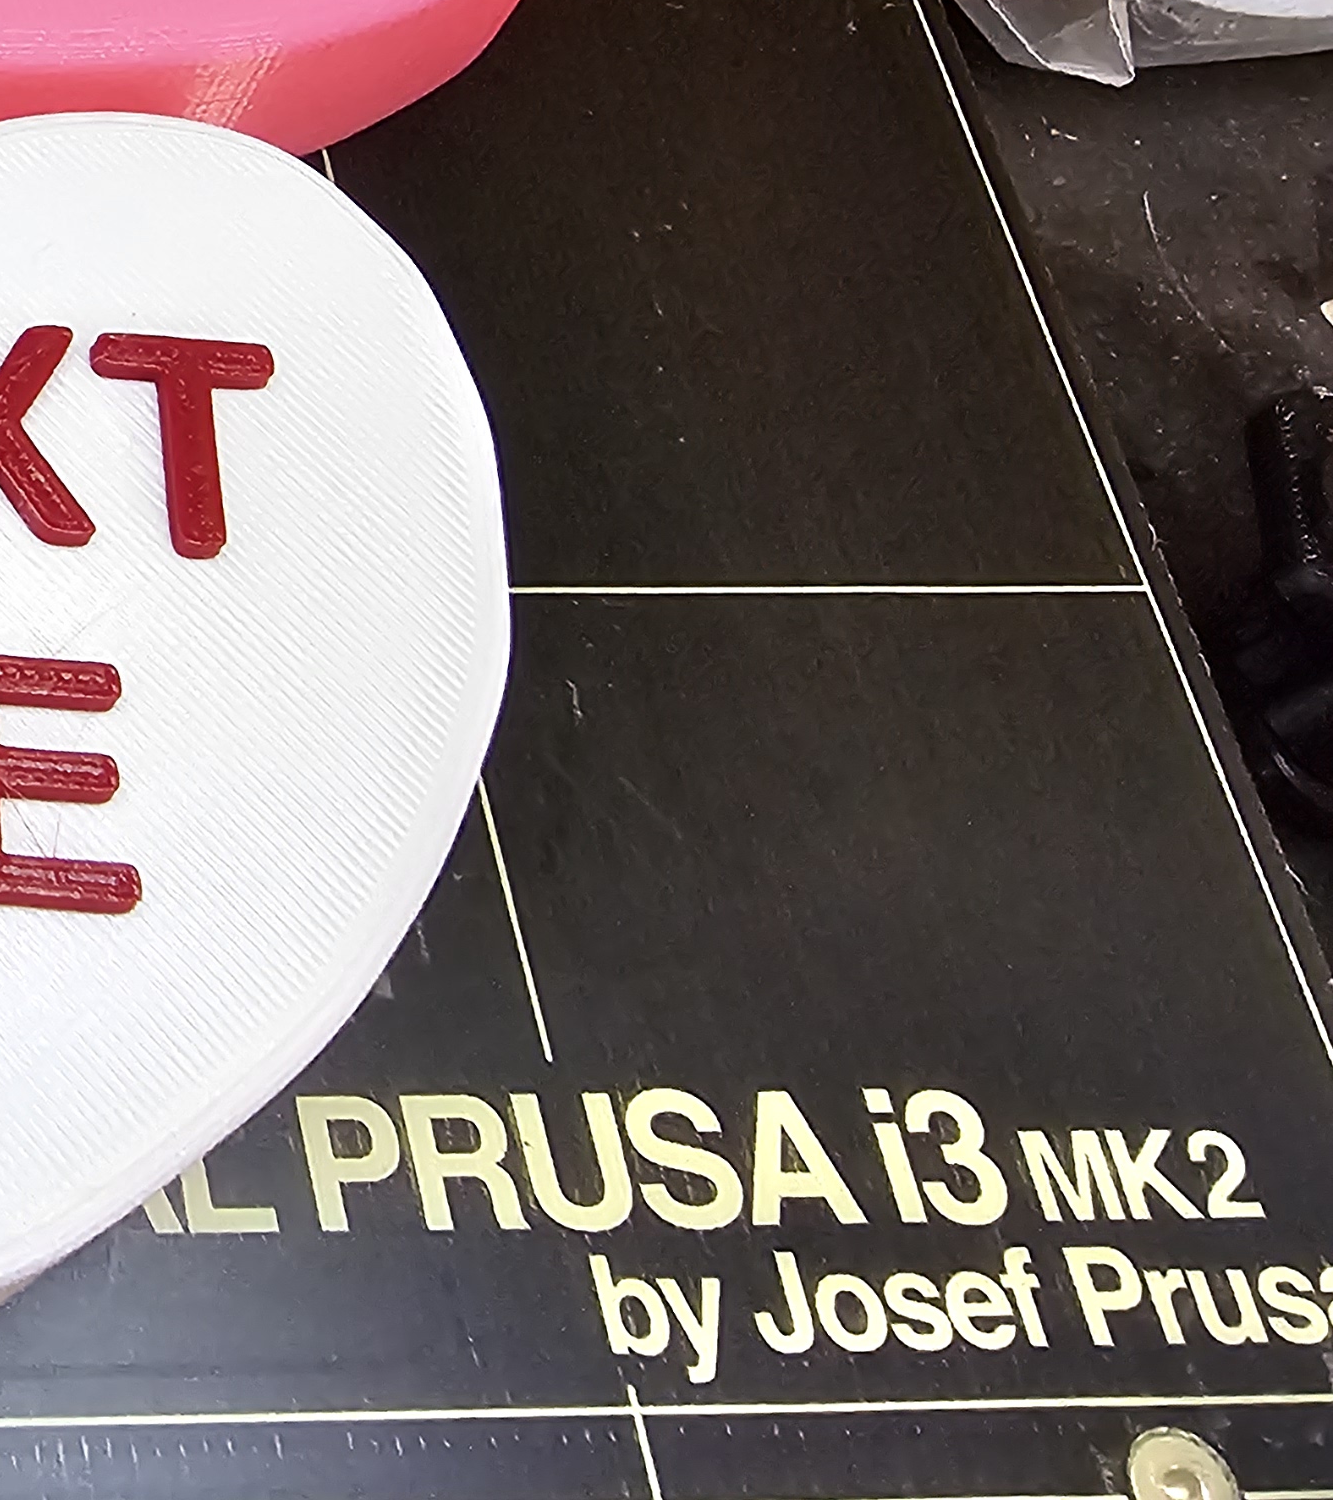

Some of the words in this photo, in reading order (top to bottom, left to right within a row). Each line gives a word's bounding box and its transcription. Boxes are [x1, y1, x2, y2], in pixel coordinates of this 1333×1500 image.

[295, 1088, 869, 1233] PRUSA
[864, 1086, 1009, 1227] i3
[1016, 1128, 1267, 1222] MK2
[589, 1252, 722, 1385] by
[754, 1245, 1050, 1356] Josef
